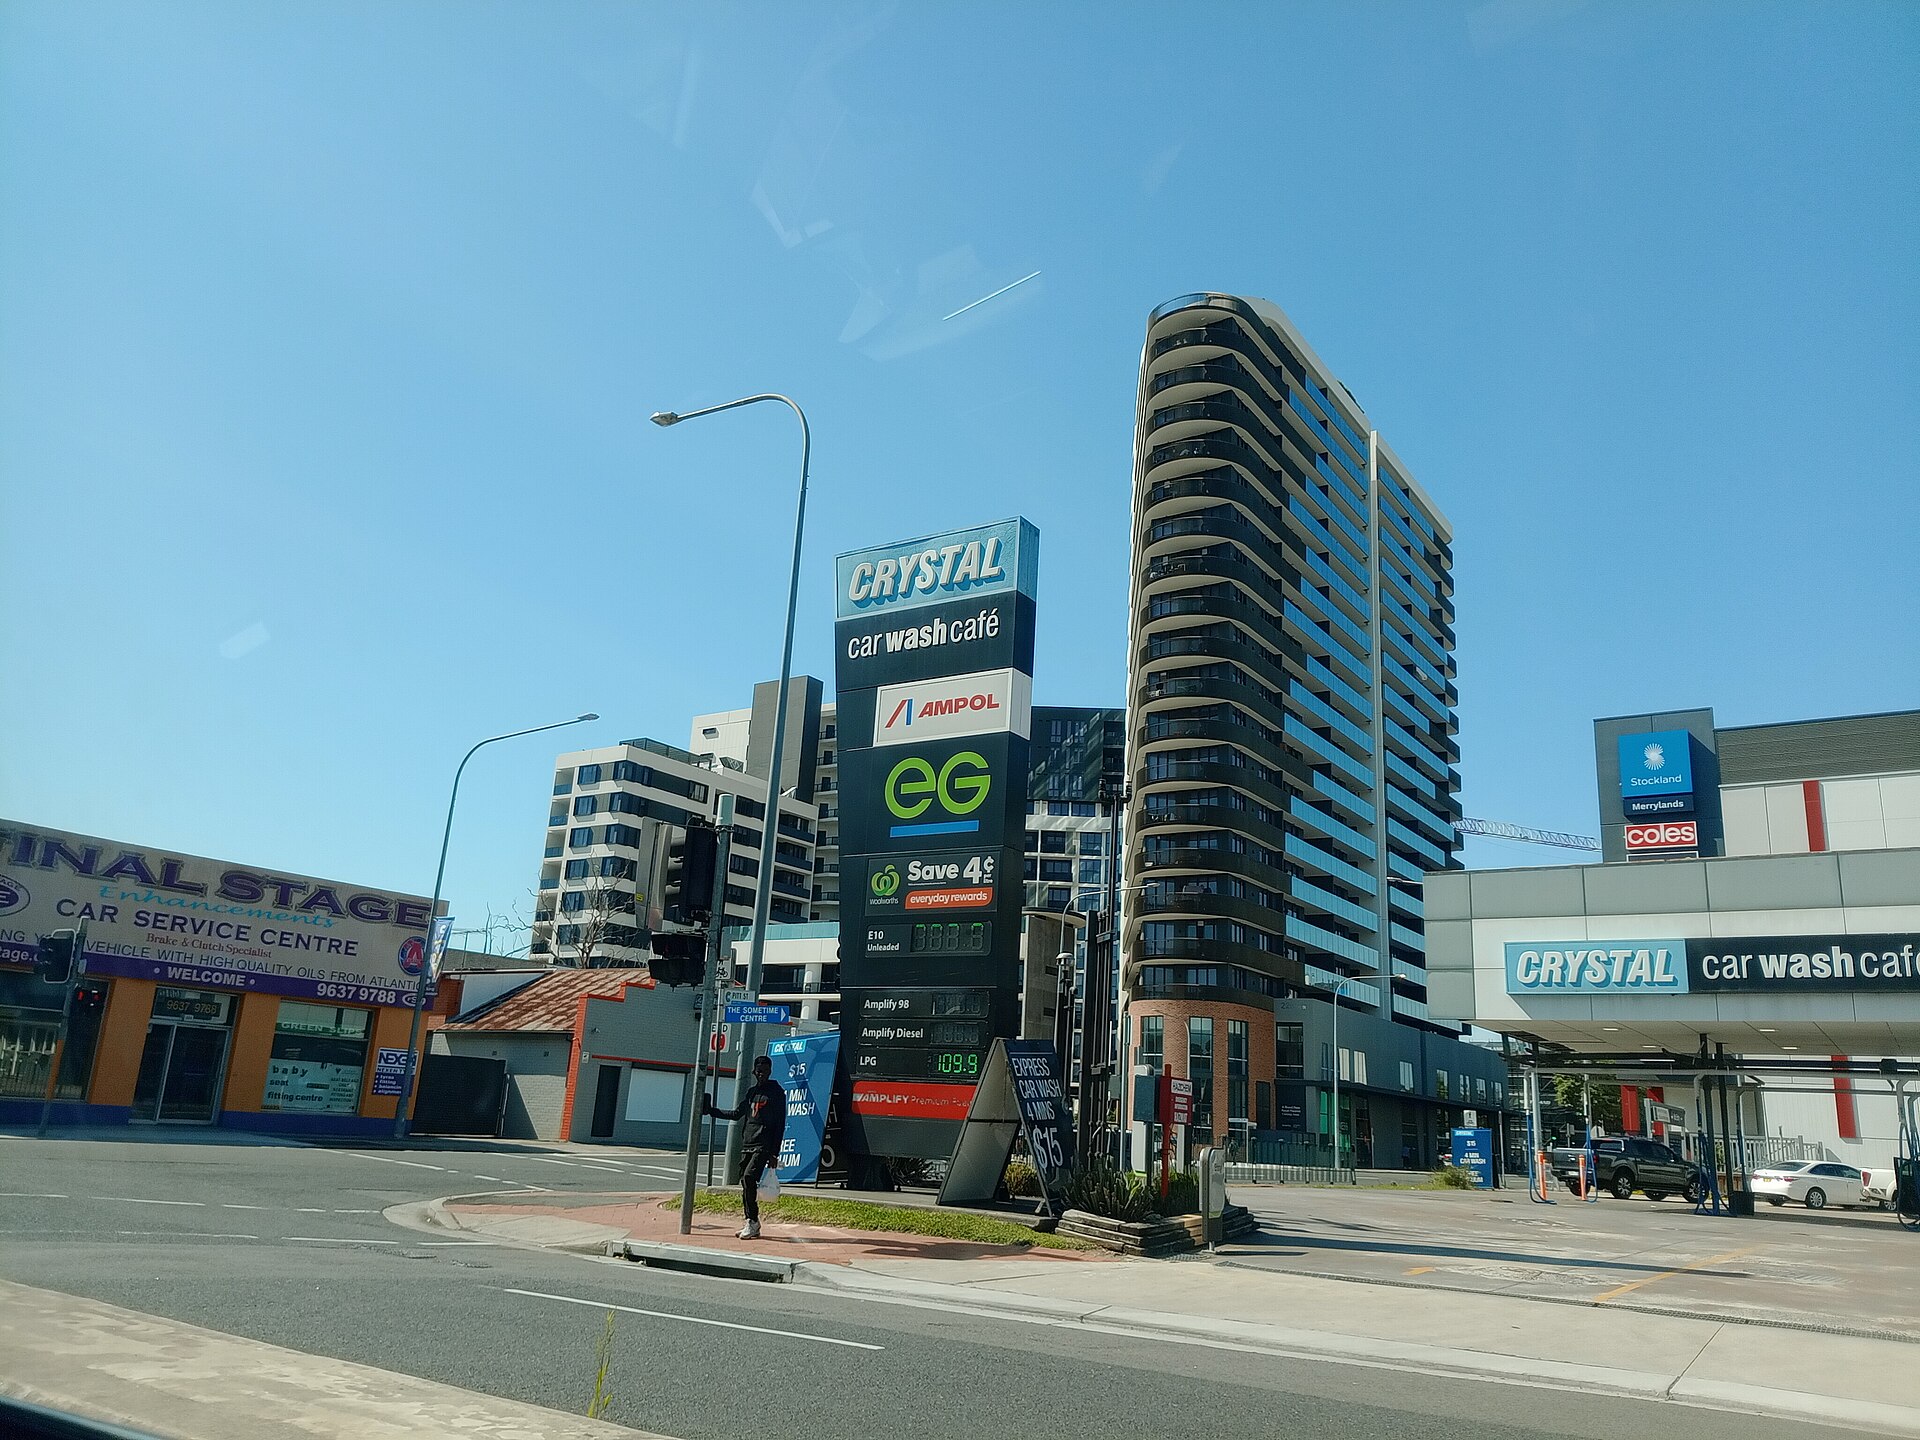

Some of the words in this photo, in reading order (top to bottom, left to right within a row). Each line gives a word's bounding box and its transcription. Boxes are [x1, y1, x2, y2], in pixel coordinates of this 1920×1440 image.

[849, 537, 1003, 602] CRYSTAL
[848, 633, 883, 660] car
[885, 617, 947, 653] wash
[950, 607, 1000, 643] café
[917, 693, 1000, 718] AMPOL
[1630, 774, 1682, 787] Stockland
[1632, 799, 1685, 811] Merrylands
[1627, 824, 1695, 845] coles
[907, 860, 960, 881] Save
[215, 870, 434, 931] STAGE
[869, 897, 899, 905] woolworths
[910, 892, 950, 905] everyday
[950, 890, 988, 902] rewards
[99, 885, 337, 928] Enhancements
[56, 898, 120, 924] CAR
[133, 909, 251, 942] SERVICE
[260, 928, 359, 957] CENTRE
[868, 930, 884, 940] E10
[146, 932, 178, 946] Brake
[181, 937, 190, 946] &
[191, 939, 224, 952] Clutch
[226, 943, 272, 959] Specialist
[867, 942, 900, 951] Unleaded
[86, 940, 151, 958] VEHICLE
[157, 949, 194, 963] WITH
[200, 954, 234, 969] HIGH
[237, 958, 293, 976] QUALITY
[297, 967, 326, 980] OILS
[330, 970, 365, 985] FROM
[1515, 948, 1677, 984] CRYSTAL
[1702, 954, 1752, 981] car
[1758, 945, 1854, 979] wash
[167, 966, 247, 986] WELCOME
[316, 983, 358, 998] 9637
[359, 987, 396, 1004] 9788
[727, 1006, 741, 1014] THE
[863, 999, 898, 1010] Amplify
[898, 999, 910, 1009] 98
[739, 1014, 767, 1022] CENTRE
[281, 1022, 324, 1032] GREEN
[711, 1024, 728, 1033] ED
[861, 1027, 895, 1039] Amplify
[896, 1028, 924, 1038] Diesel
[859, 1056, 877, 1066] LPG
[937, 1053, 978, 1074] 109.9
[1011, 1057, 1051, 1077] EXPRESS
[788, 1063, 806, 1077] $15
[269, 1078, 289, 1086] seat
[1018, 1080, 1039, 1099] CAR
[1036, 1079, 1062, 1098] WASH
[267, 1091, 294, 1102] fitting
[296, 1093, 323, 1102] centre
[788, 1089, 808, 1102] MIN
[861, 1092, 910, 1104] AMPLIFY
[787, 1102, 815, 1116] WASH
[1026, 1102, 1035, 1121] 4
[1035, 1100, 1056, 1121] MINS
[1032, 1124, 1064, 1174] $15
